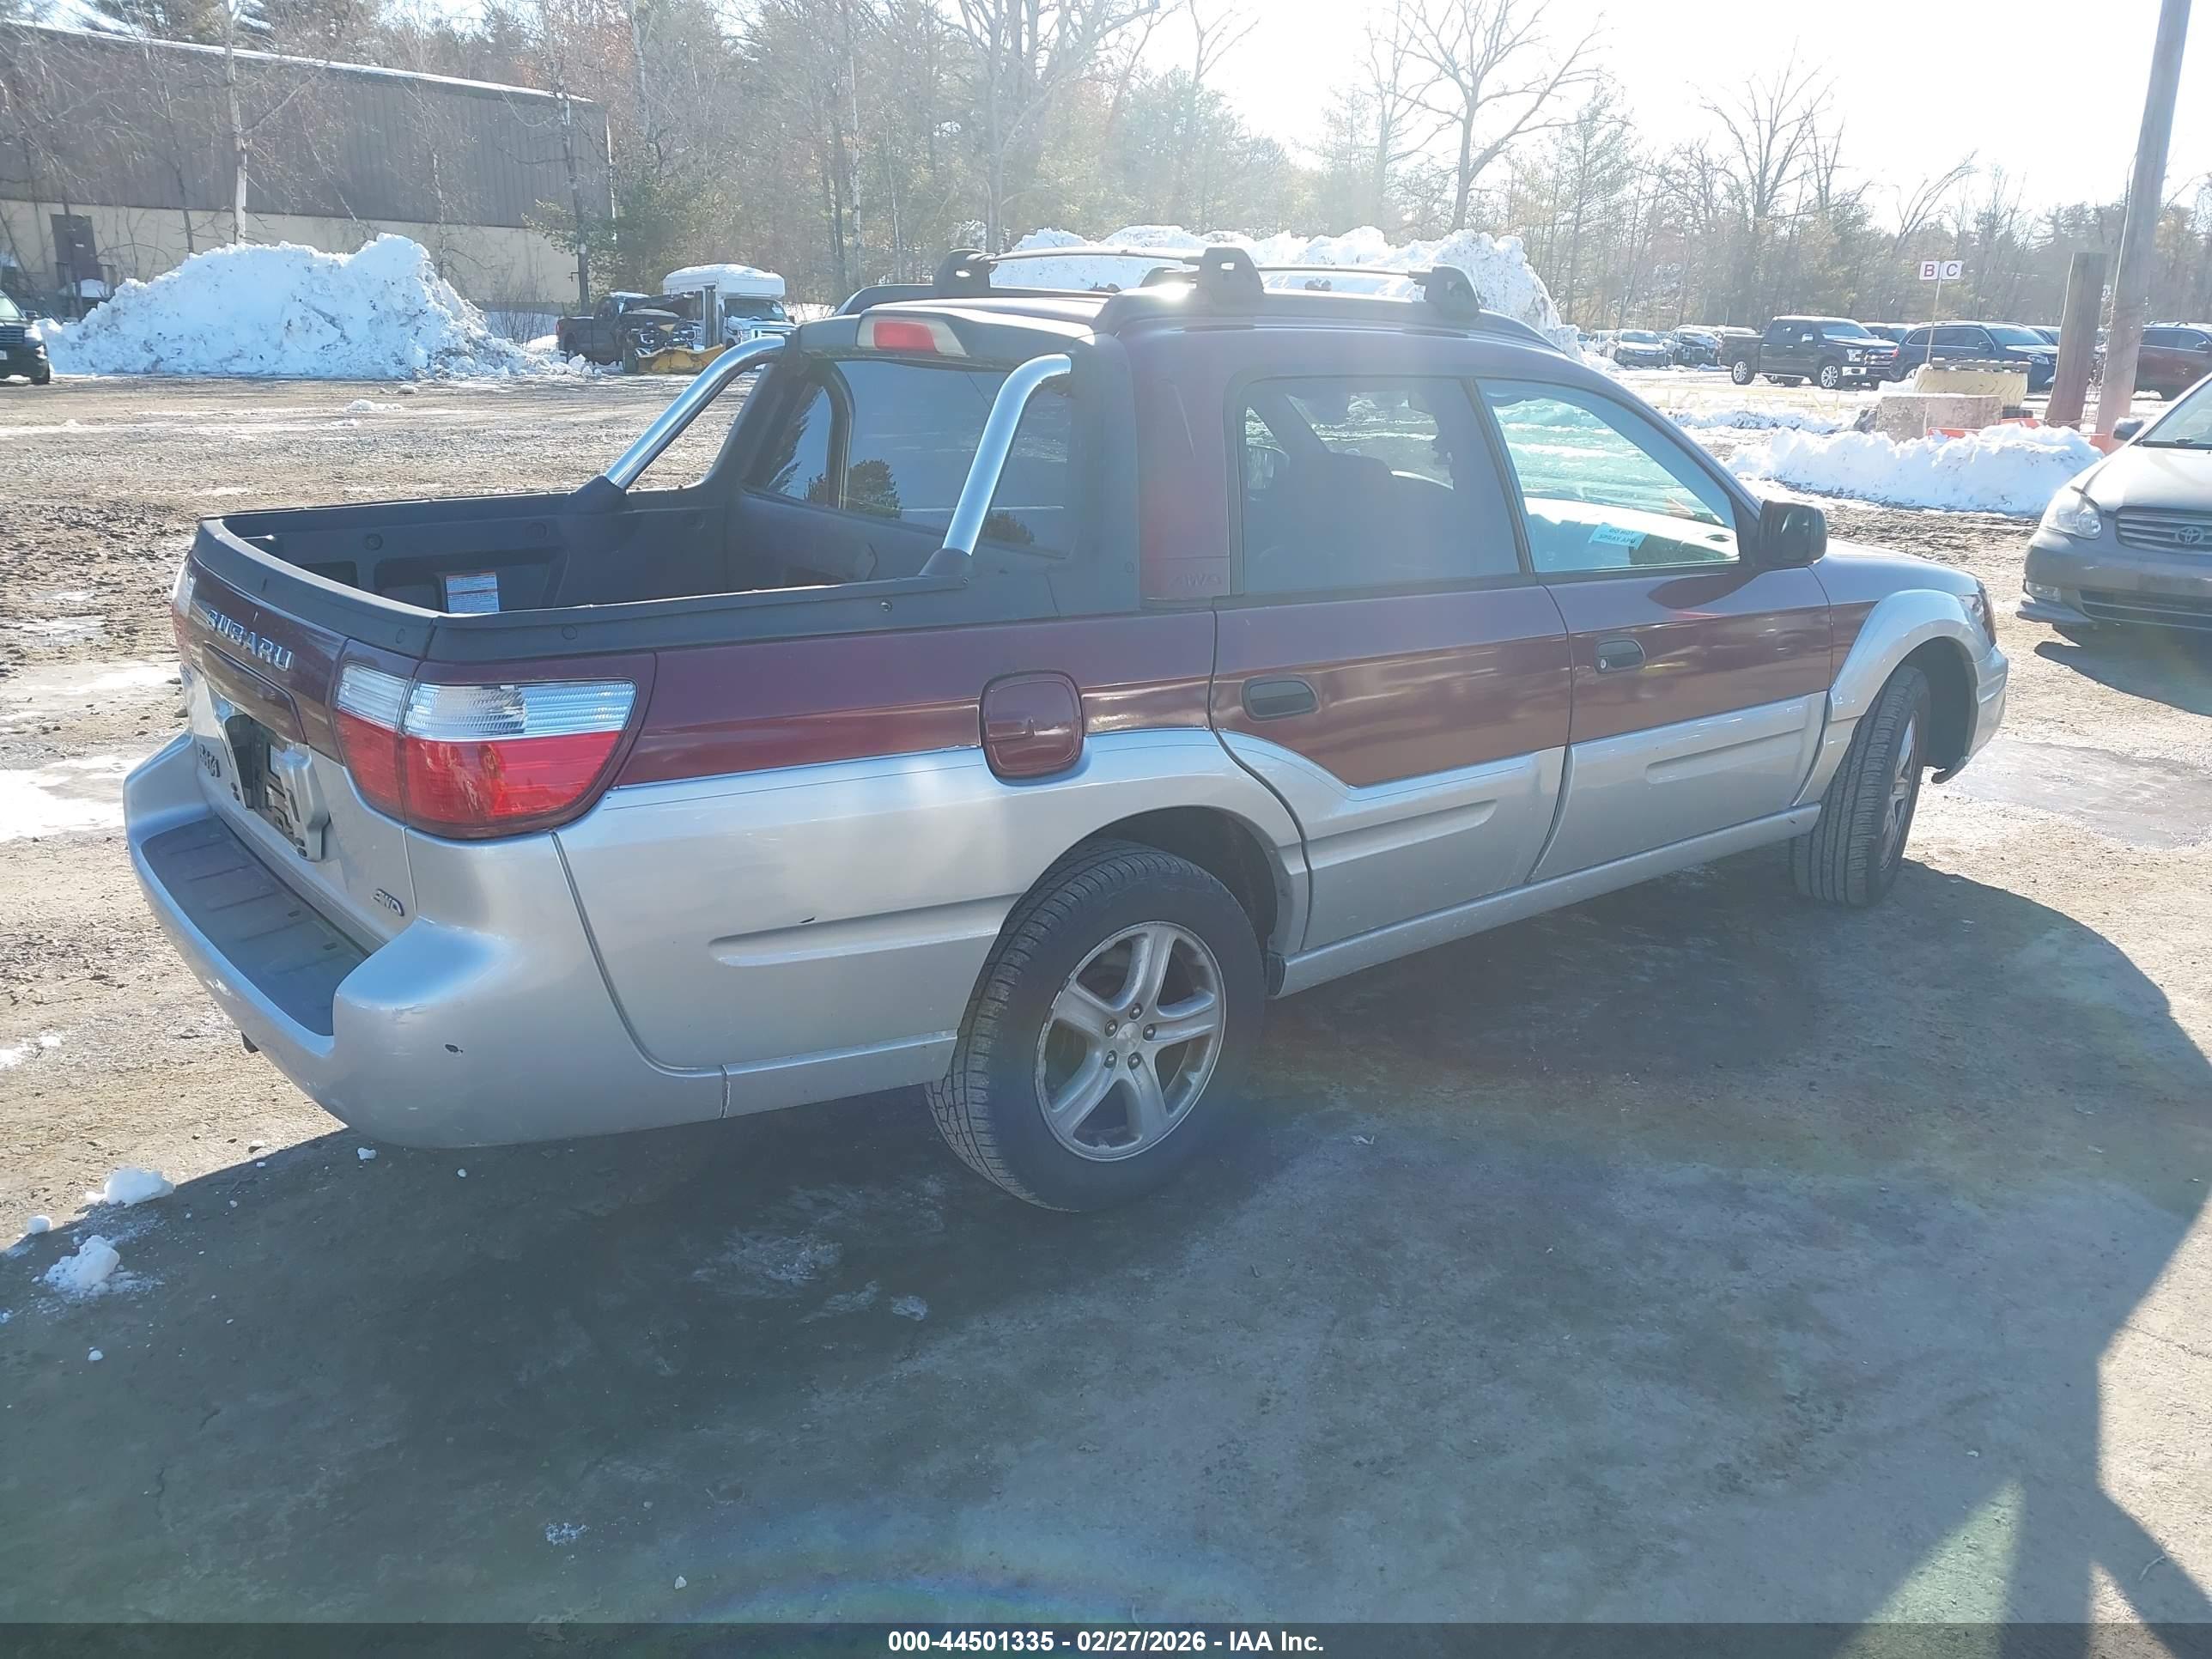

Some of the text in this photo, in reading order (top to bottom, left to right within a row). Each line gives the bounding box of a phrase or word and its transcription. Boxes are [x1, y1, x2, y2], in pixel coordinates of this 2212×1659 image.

[1923, 264, 1959, 277] B C
[205, 609, 295, 672] SUBARU
